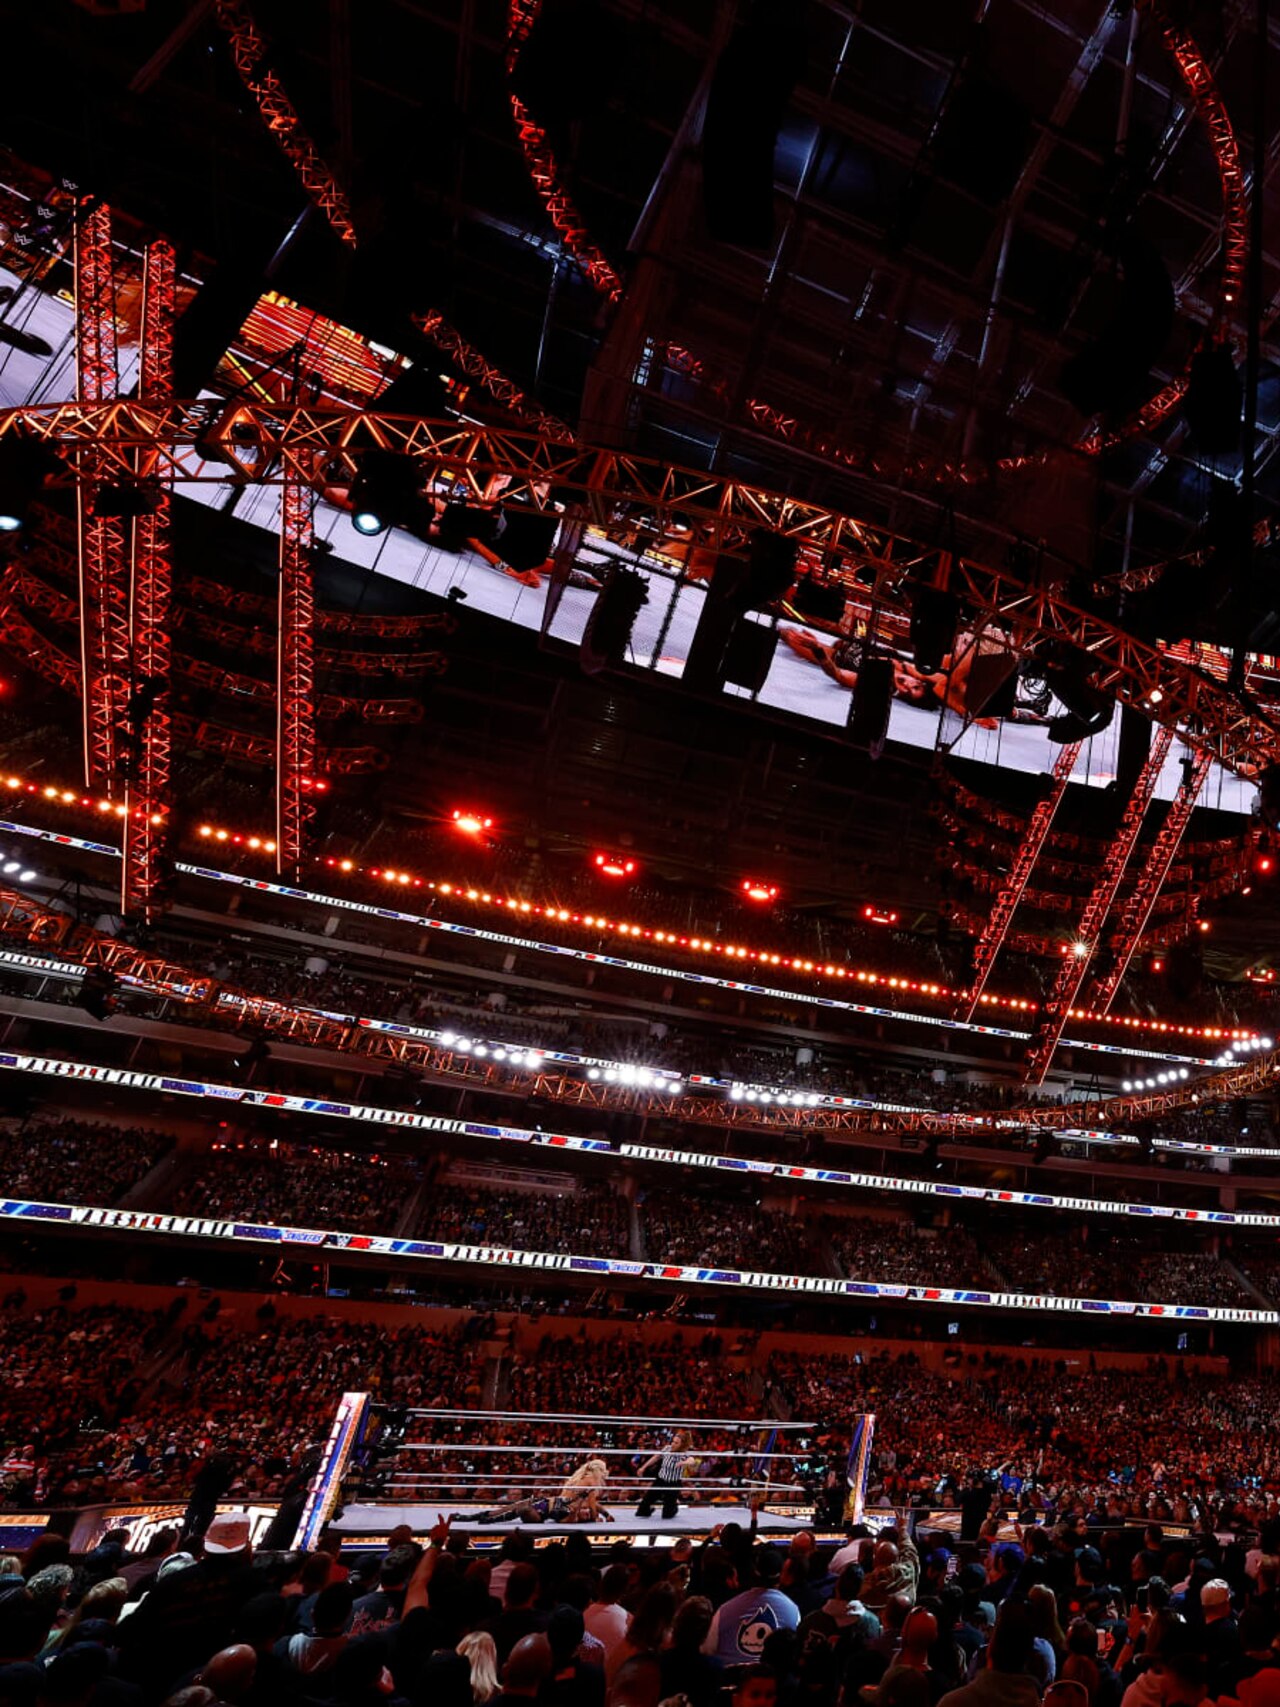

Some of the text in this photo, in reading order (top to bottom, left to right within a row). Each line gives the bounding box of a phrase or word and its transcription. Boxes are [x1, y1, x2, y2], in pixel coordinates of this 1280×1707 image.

[17, 1056, 161, 1088] WRESTLEMANIA
[350, 1106, 465, 1132] WRESTLEMANIA
[71, 1207, 234, 1235] WRESTLEMANIA
[443, 1245, 570, 1268] WRESTLEMANIA
[739, 1273, 846, 1292] WRESTLEMANIA
